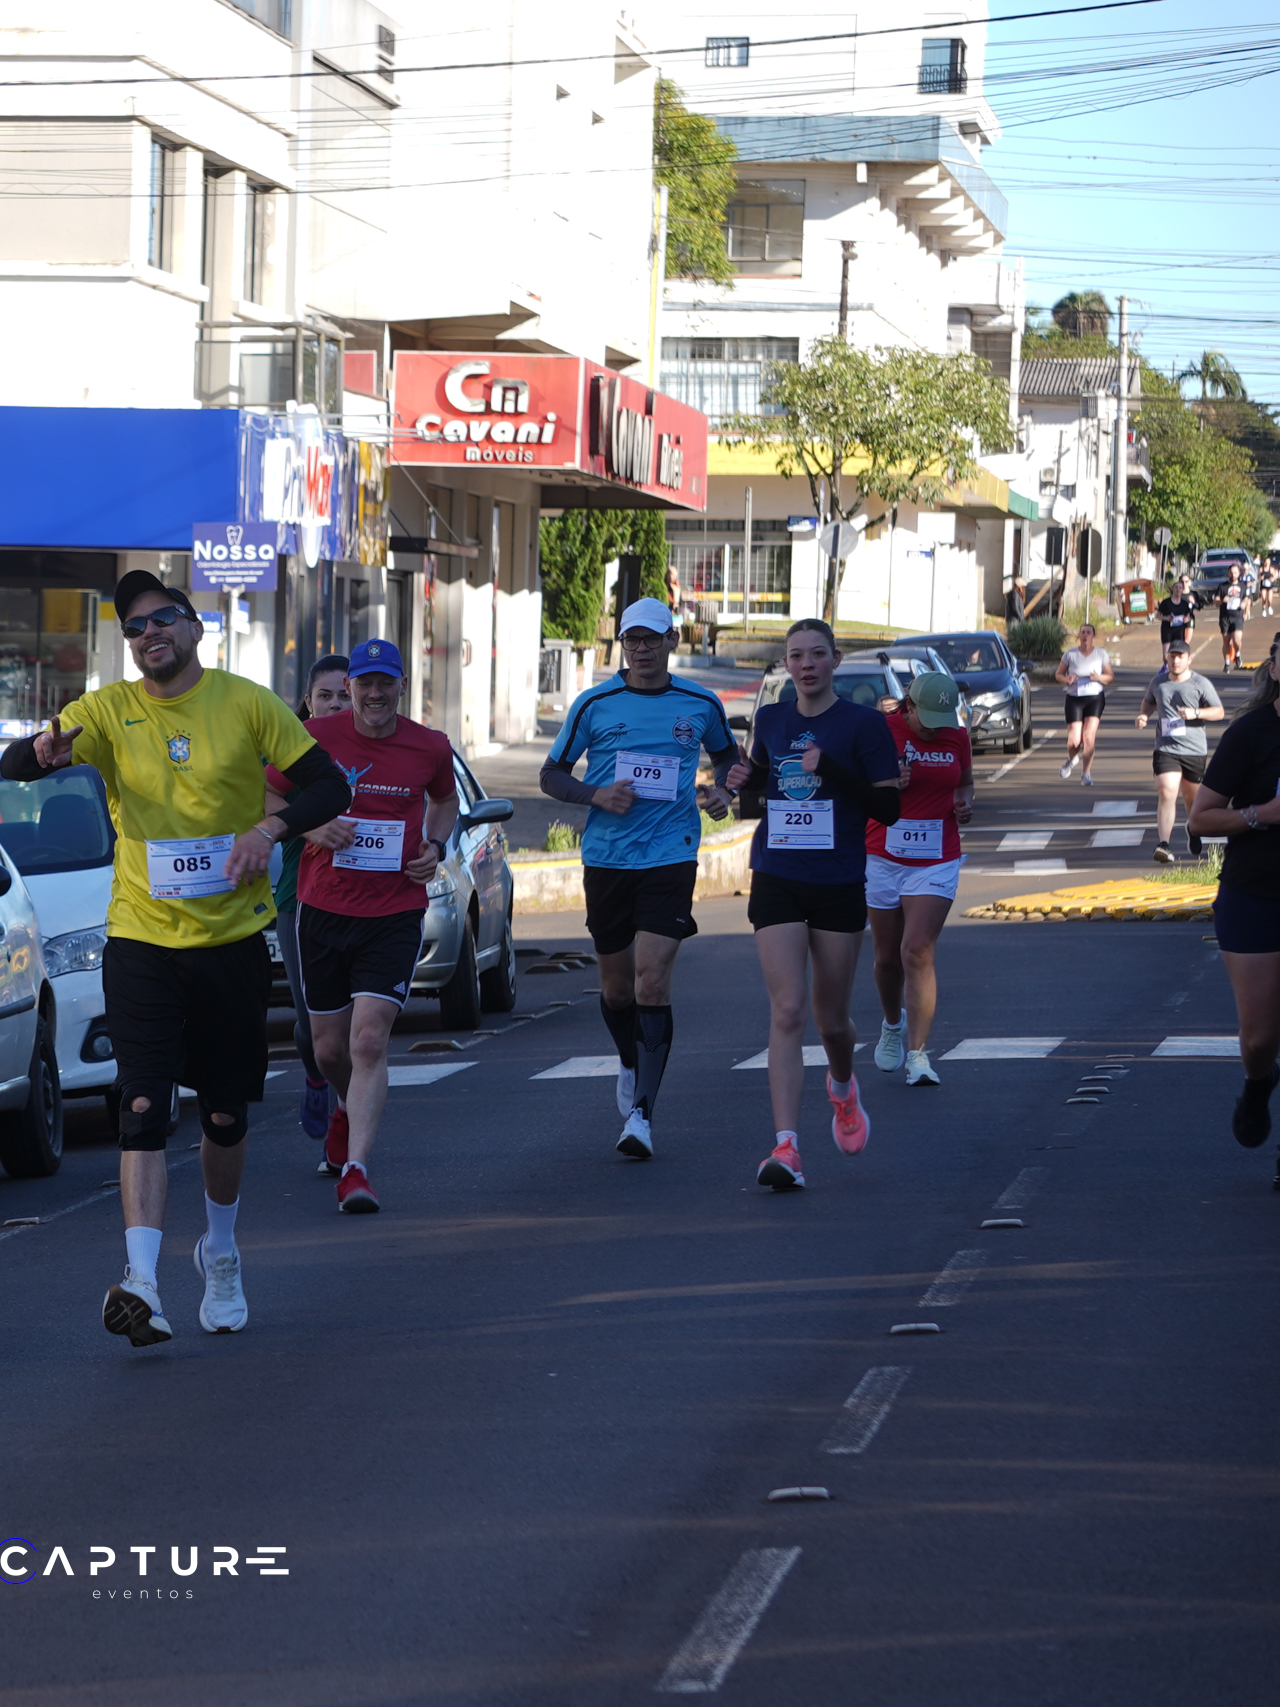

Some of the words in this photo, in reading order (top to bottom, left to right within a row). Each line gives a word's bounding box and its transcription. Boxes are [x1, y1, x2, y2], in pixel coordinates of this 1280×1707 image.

[415, 412, 557, 443] Cavani
[193, 540, 275, 561] Nossa
[633, 766, 661, 780] 079
[785, 812, 813, 825] 220
[354, 835, 385, 849] 206
[903, 831, 927, 842] 011
[173, 856, 212, 873] 085
